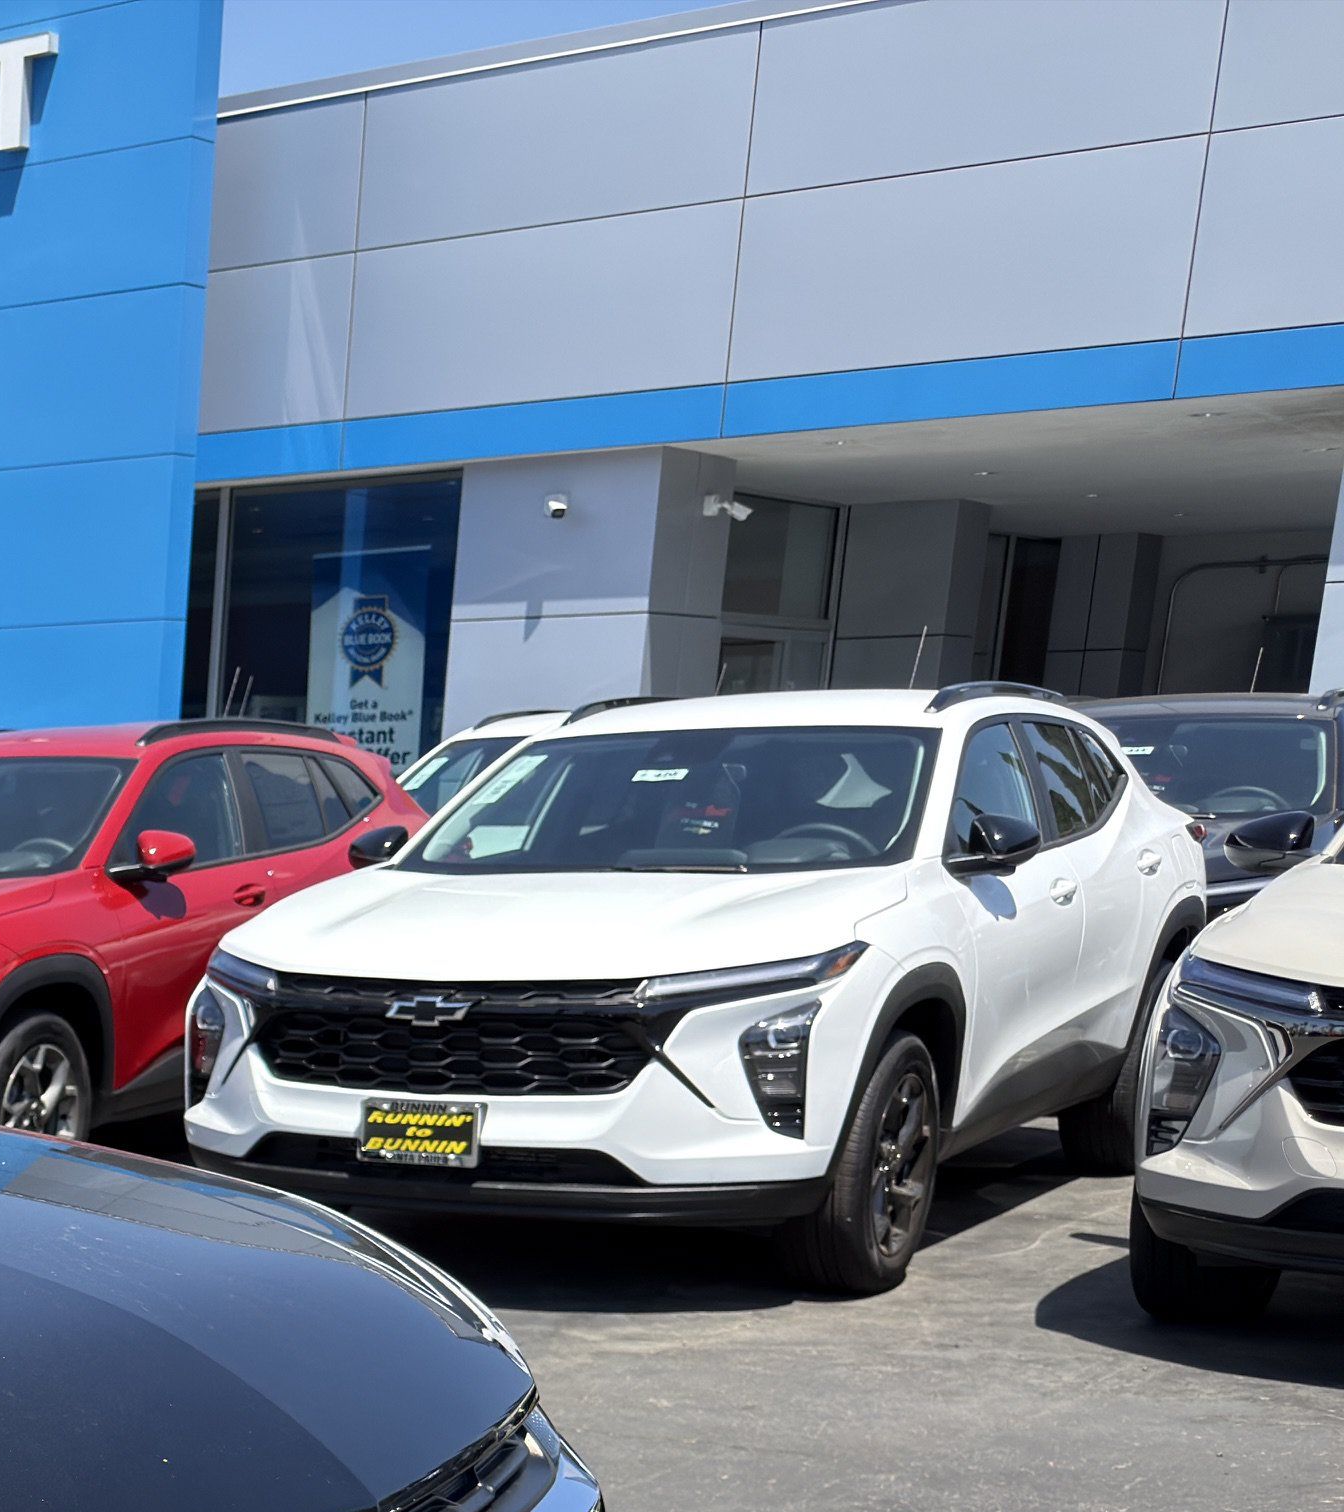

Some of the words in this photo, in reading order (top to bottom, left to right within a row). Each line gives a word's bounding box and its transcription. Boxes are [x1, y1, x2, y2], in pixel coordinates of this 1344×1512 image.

[350, 700, 369, 710] Get
[314, 712, 348, 725] Kelley
[351, 711, 377, 722] Blue
[405, 1126, 433, 1138] to
[365, 1137, 468, 1154] BUNNIN
